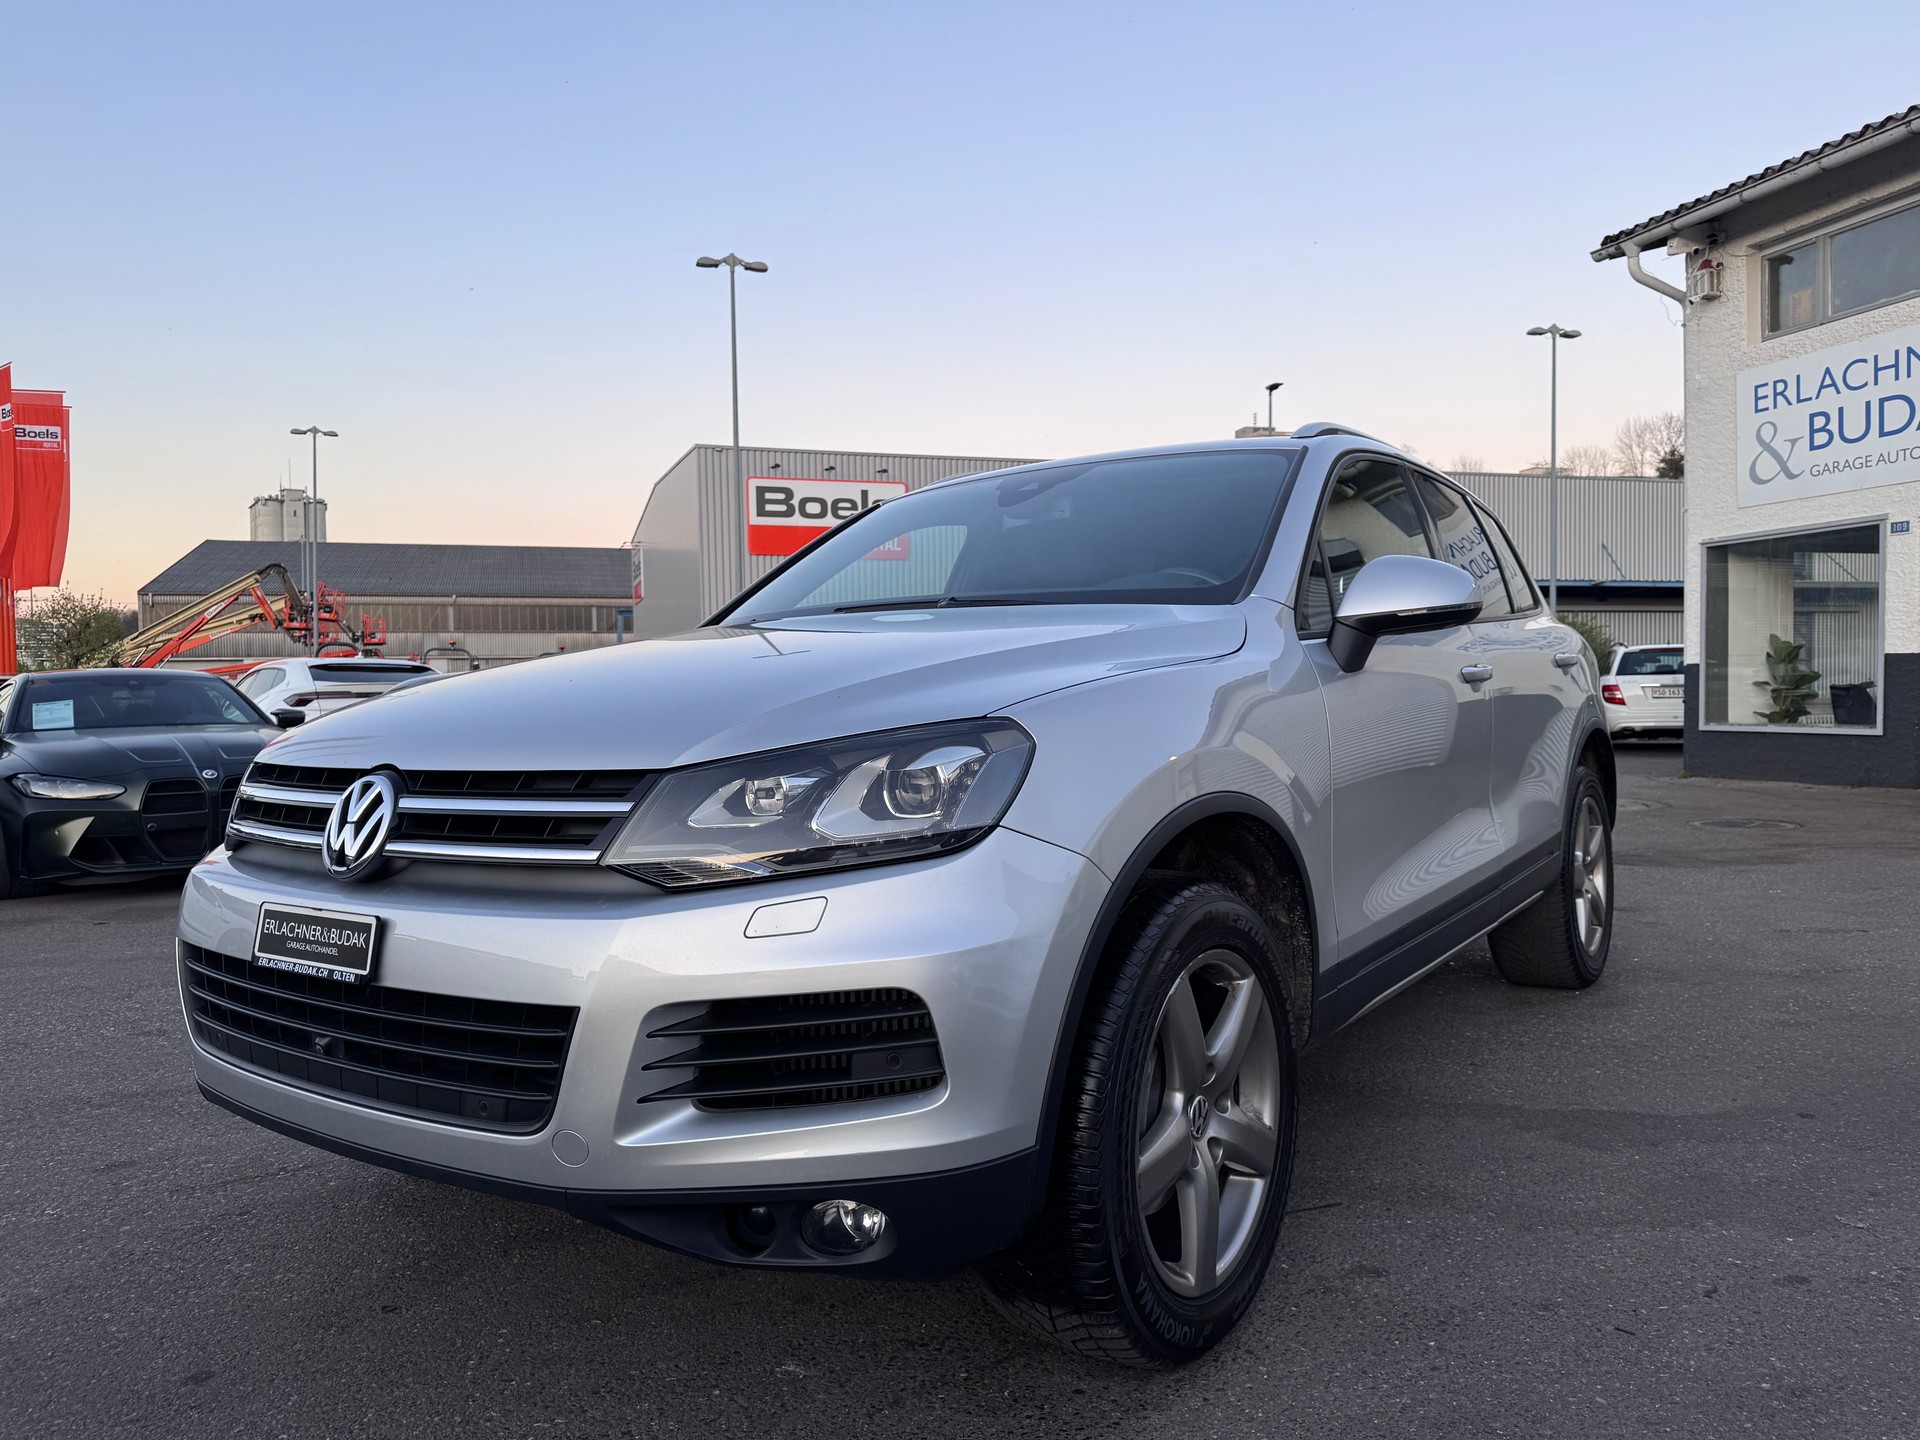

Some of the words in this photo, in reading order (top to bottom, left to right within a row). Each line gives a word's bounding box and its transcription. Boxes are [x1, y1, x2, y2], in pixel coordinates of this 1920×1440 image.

[14, 427, 59, 439] Boels
[1749, 420, 1805, 485] &
[1809, 394, 1920, 451] BUD
[1809, 454, 1873, 477] GARAGE
[1893, 522, 1908, 532] 109
[286, 940, 306, 951] GARAGE
[305, 944, 338, 956] AUTOHANDEL
[258, 957, 329, 979] ERLACHNER-BUDAK.CH
[332, 971, 356, 983] OLTEN
[1135, 1272, 1196, 1345] YOKOHAMA
